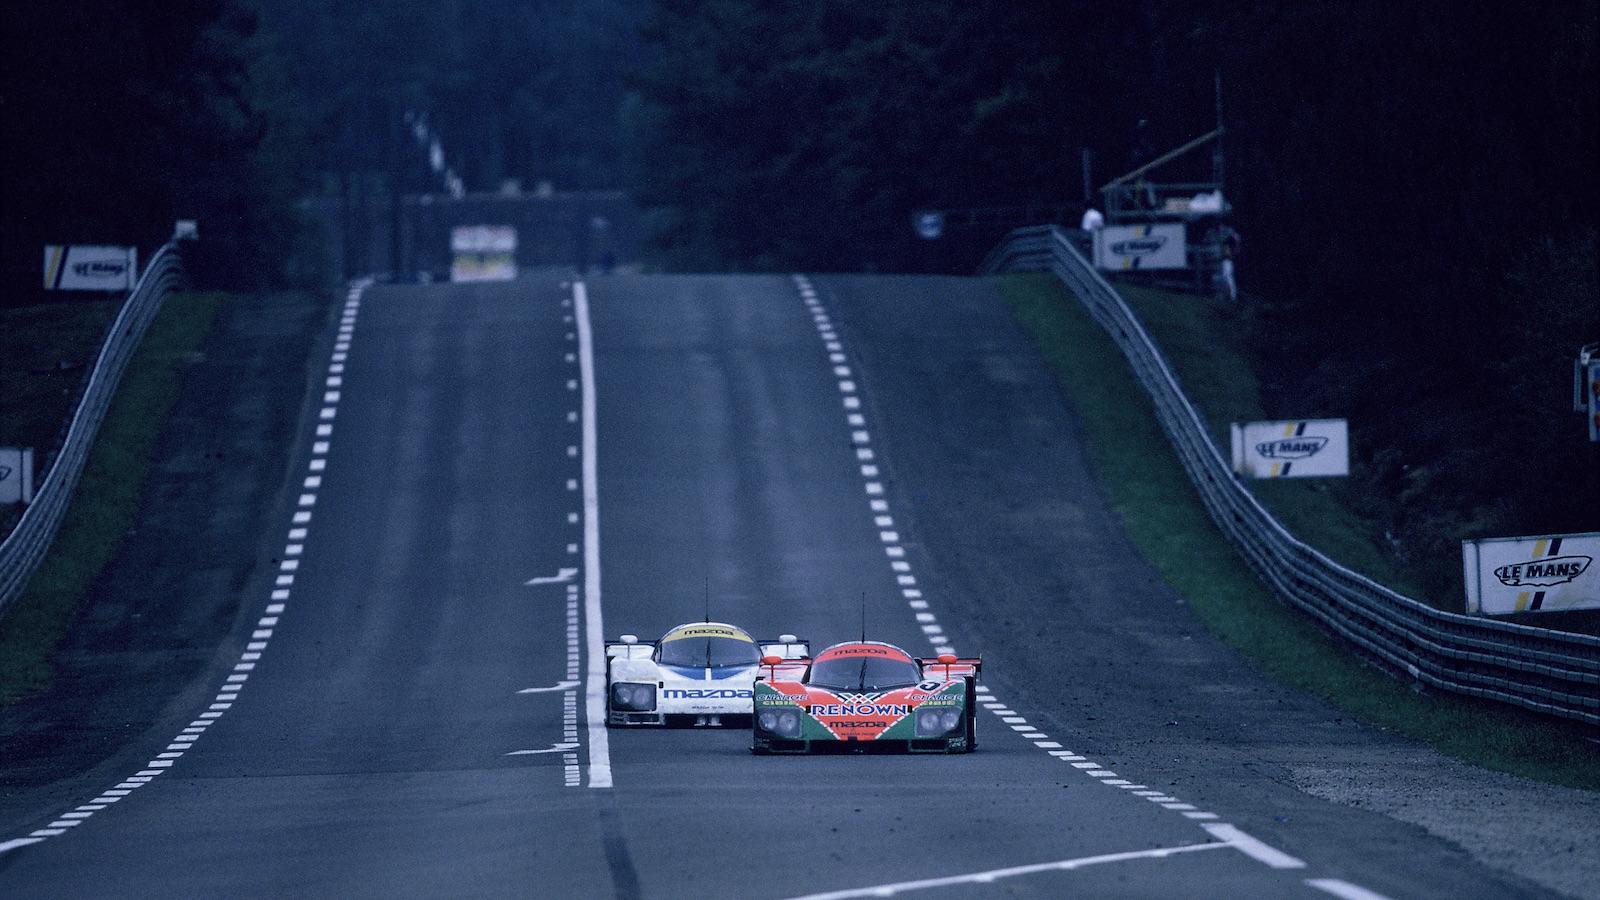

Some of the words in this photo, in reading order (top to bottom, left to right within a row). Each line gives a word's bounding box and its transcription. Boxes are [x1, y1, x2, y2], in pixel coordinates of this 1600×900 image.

[1501, 566, 1521, 579] LE
[1527, 563, 1580, 578] MANS
[811, 704, 908, 716] RENOWN
